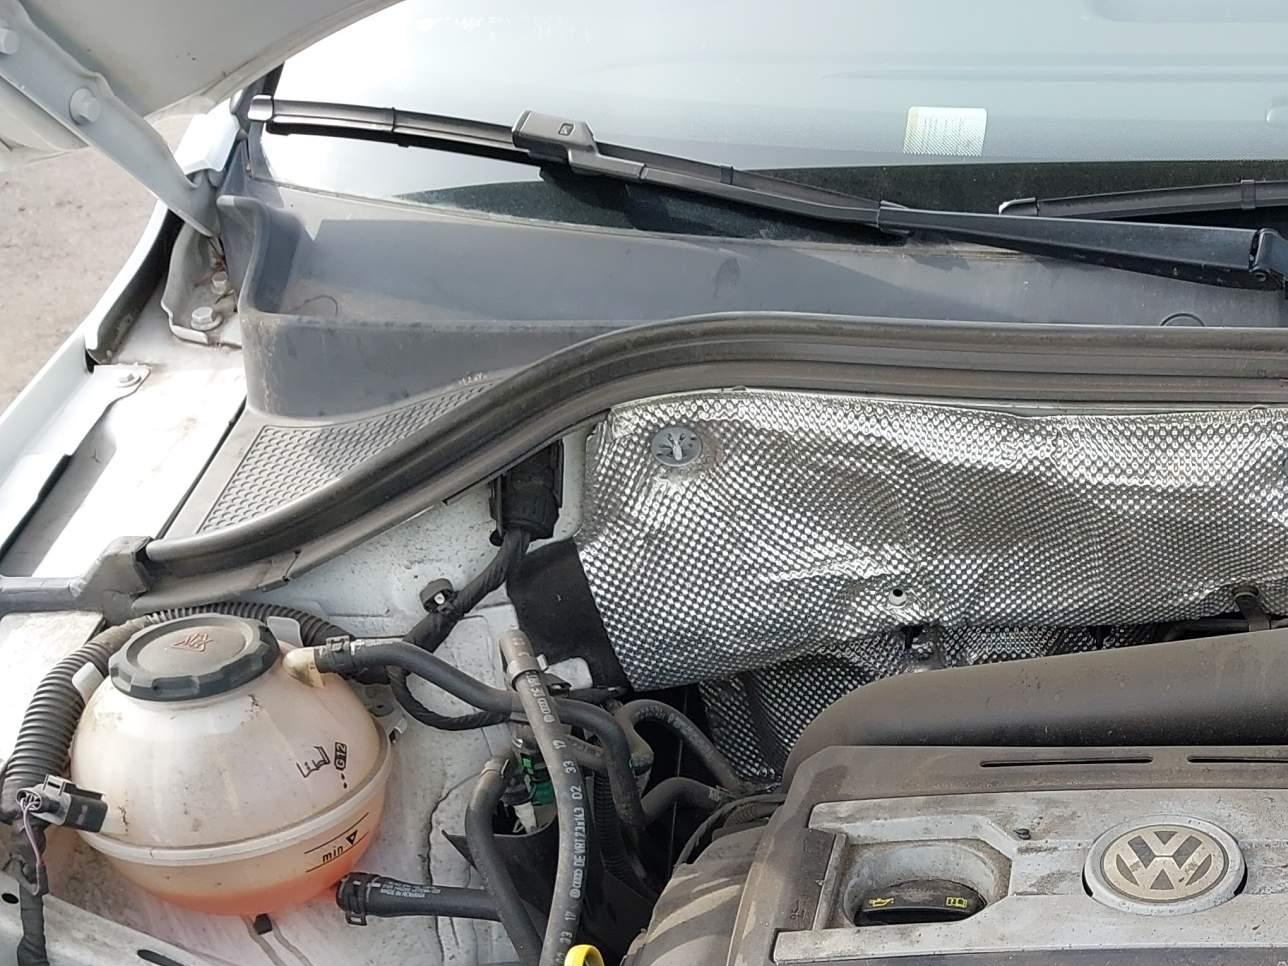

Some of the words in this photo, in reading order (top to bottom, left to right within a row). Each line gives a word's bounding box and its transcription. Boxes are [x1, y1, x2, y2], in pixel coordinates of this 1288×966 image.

[335, 743, 347, 769] G12
[563, 760, 577, 774] 33
[322, 845, 344, 863] min
